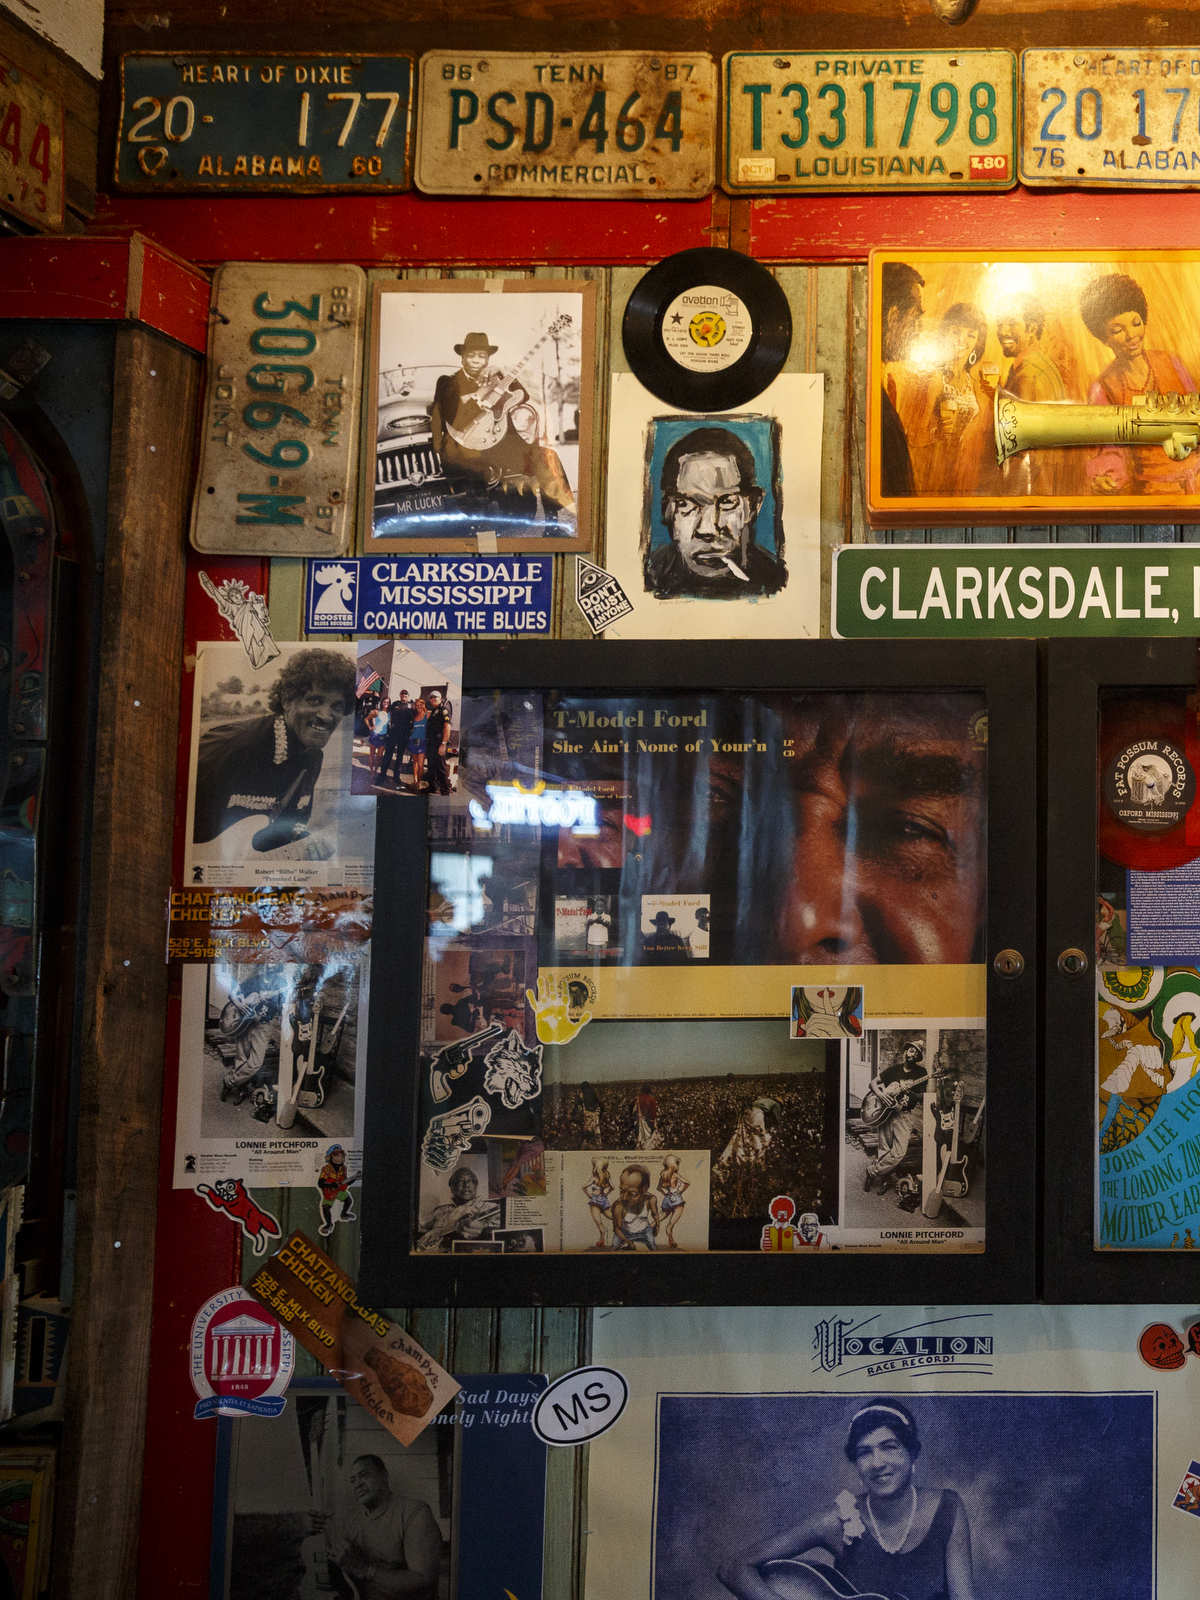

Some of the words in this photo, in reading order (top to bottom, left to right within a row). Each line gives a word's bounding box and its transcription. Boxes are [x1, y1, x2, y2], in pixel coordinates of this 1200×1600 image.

[182, 65, 252, 84] HEART
[260, 66, 286, 84] OF
[295, 65, 353, 84] DIXIE
[814, 59, 924, 77] PRIVATE
[449, 88, 684, 154] PSD-464
[742, 81, 999, 151] T331798
[198, 156, 322, 176] ALABAMA
[352, 156, 382, 176] 60
[795, 155, 946, 178] LOUISIANA
[1032, 147, 1066, 169] 76
[487, 163, 646, 184] COMMERCIAL
[682, 296, 719, 305] ovation
[397, 500, 414, 513] MR
[414, 495, 444, 512] LUCKY
[372, 562, 543, 582] CLARKSDALE
[380, 586, 533, 605] MISSISSIPPI
[580, 580, 618, 611] DON'T
[586, 590, 624, 619] TRUST
[859, 566, 1183, 628] CLARKSDALE,
[314, 613, 354, 622] ROOSTER
[363, 611, 447, 631] COAHOMA
[454, 611, 487, 631] THE
[492, 610, 547, 630] BLUES
[593, 600, 631, 627] ANYONE
[553, 709, 644, 728] T-Model
[653, 709, 708, 728] Ford
[783, 739, 795, 747] LP
[783, 750, 796, 758] CD
[1117, 741, 1159, 770] POSSUM
[1161, 745, 1186, 798] RECORDS
[1114, 772, 1128, 796] FAT
[1145, 810, 1179, 819] MISSISSIPPI
[235, 1141, 267, 1149] LONNIE
[269, 1141, 319, 1149] PITCHFORD
[1103, 1149, 1146, 1175] JOHN
[1145, 1119, 1179, 1154] LEE
[1102, 1179, 1119, 1199] THE
[1122, 1153, 1183, 1201] LOADING
[1100, 1201, 1186, 1243] MOTHER
[880, 1231, 913, 1239] LONNIE
[915, 1231, 964, 1239] PITCHFORD
[277, 1249, 335, 1306] CHICKEN
[194, 1290, 243, 1350] UNIVERSITY
[194, 1354, 203, 1377] THE
[867, 1361, 897, 1376] RACE
[902, 1354, 956, 1370] RECORDS
[456, 1390, 490, 1405] Sad
[494, 1390, 540, 1406] Days
[552, 1381, 612, 1432] MS
